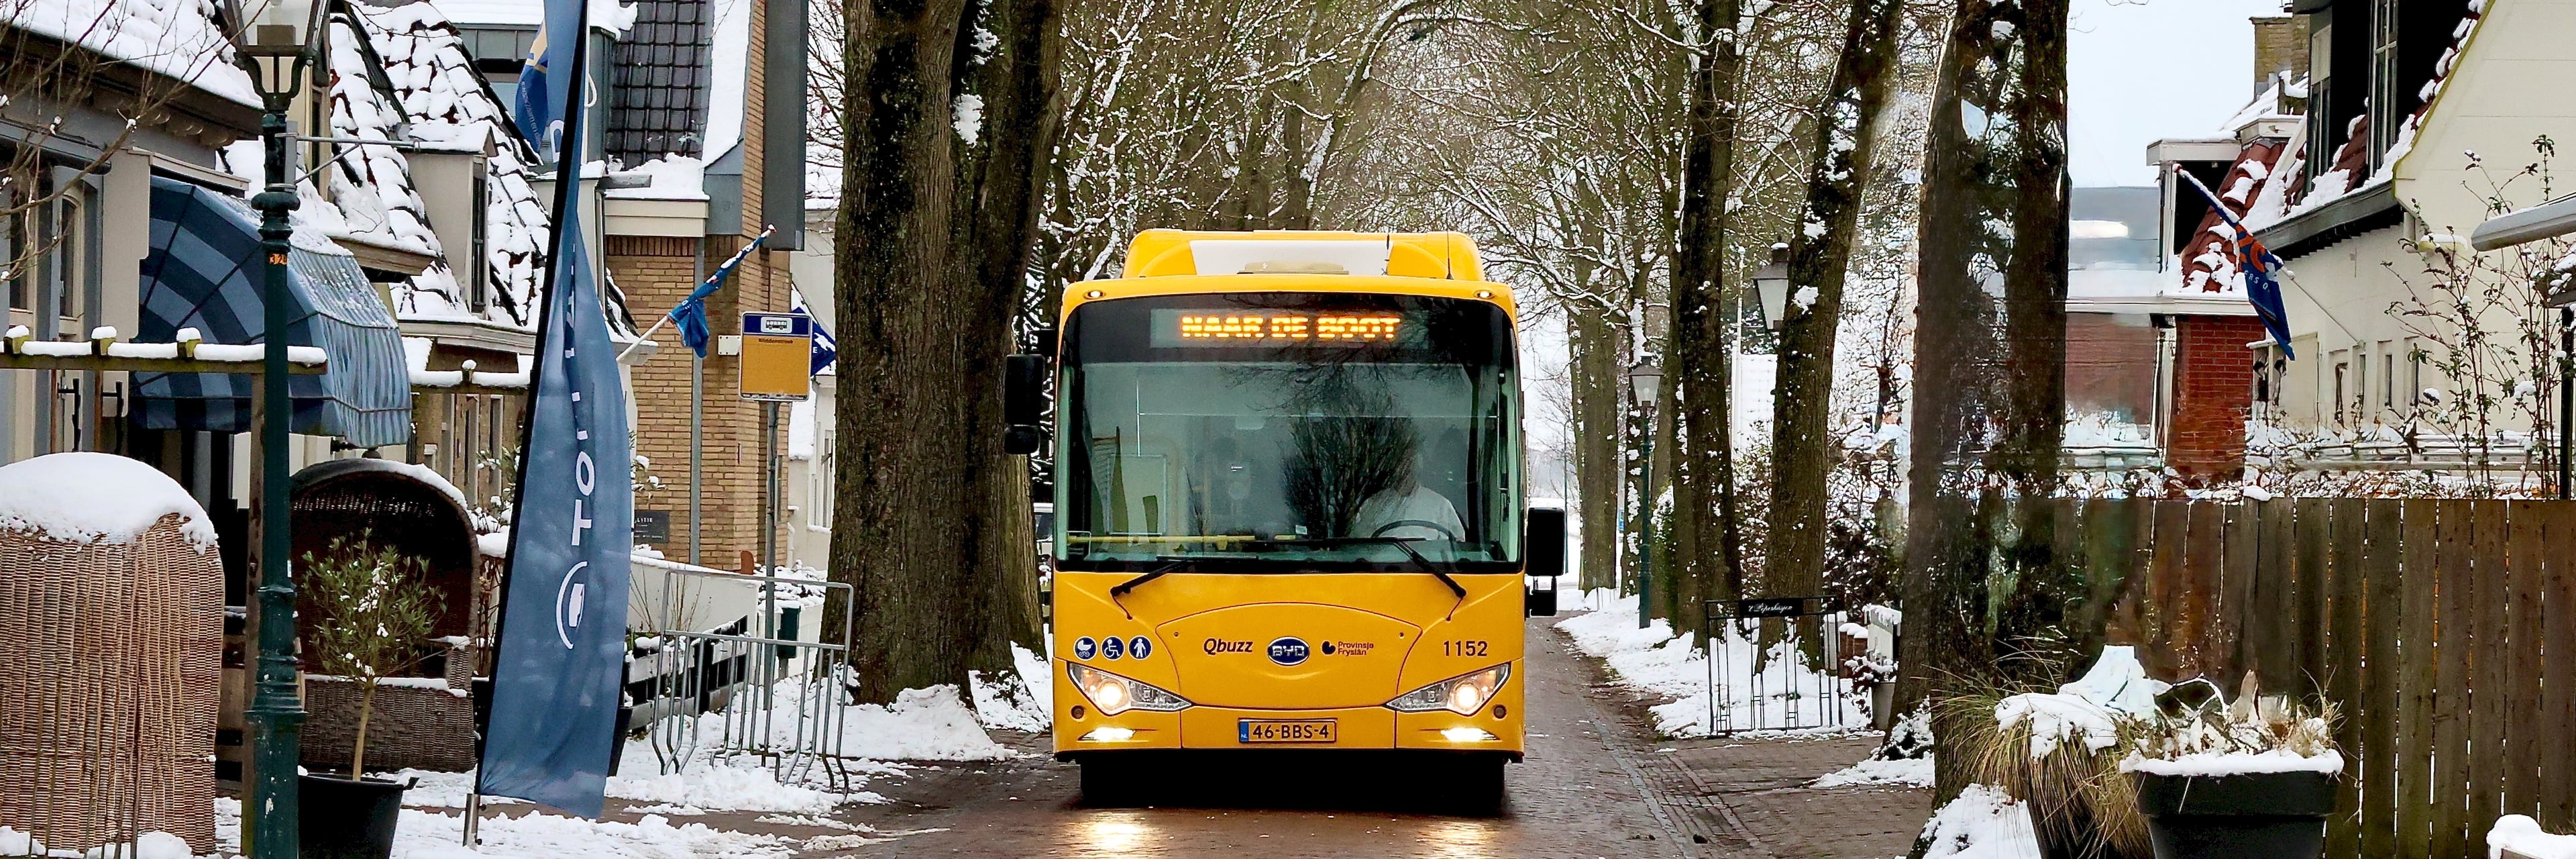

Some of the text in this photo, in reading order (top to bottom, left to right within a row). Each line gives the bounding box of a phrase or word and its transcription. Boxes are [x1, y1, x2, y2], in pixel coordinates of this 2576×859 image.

[1182, 316, 1401, 338] NAAR DE BOOT
[1203, 638, 1253, 656] Qbuzz
[1272, 646, 1305, 657] BYD
[1443, 640, 1488, 656] 1152
[1252, 725, 1330, 739] 46-BBS-4
